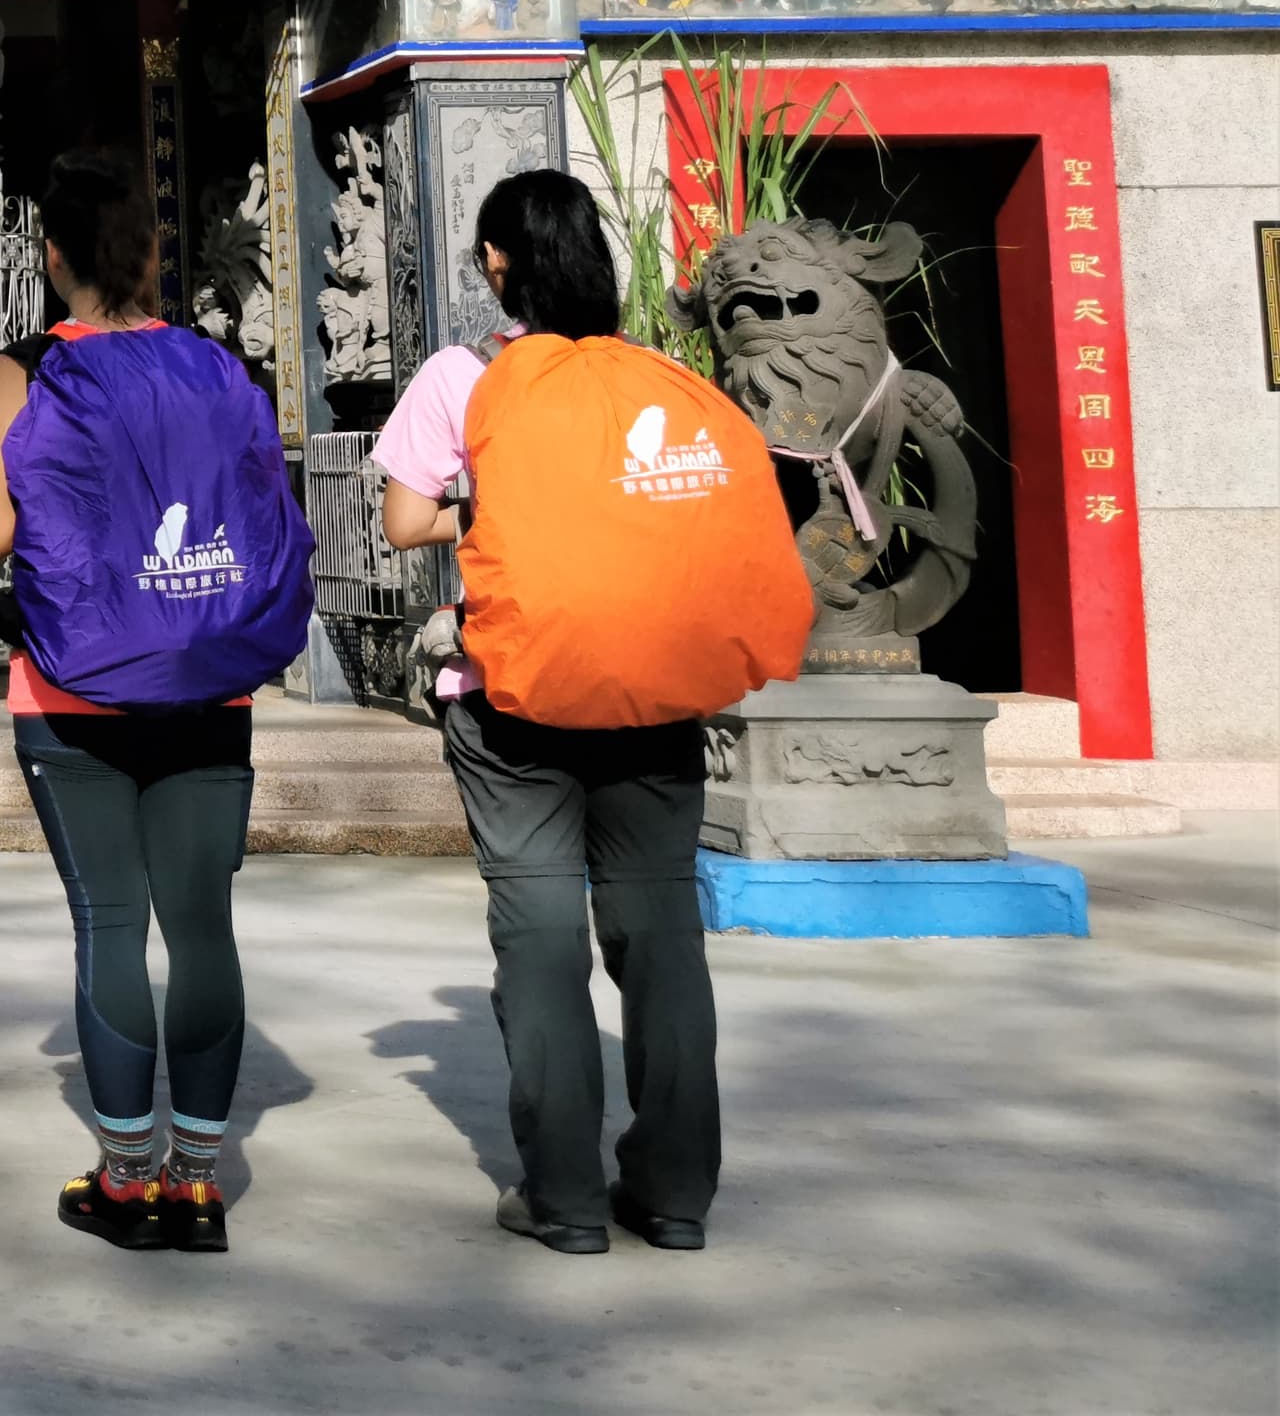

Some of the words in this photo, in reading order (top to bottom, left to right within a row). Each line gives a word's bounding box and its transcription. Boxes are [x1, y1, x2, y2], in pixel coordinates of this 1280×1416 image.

[1062, 158, 1124, 525] 聖德配天恩周四海
